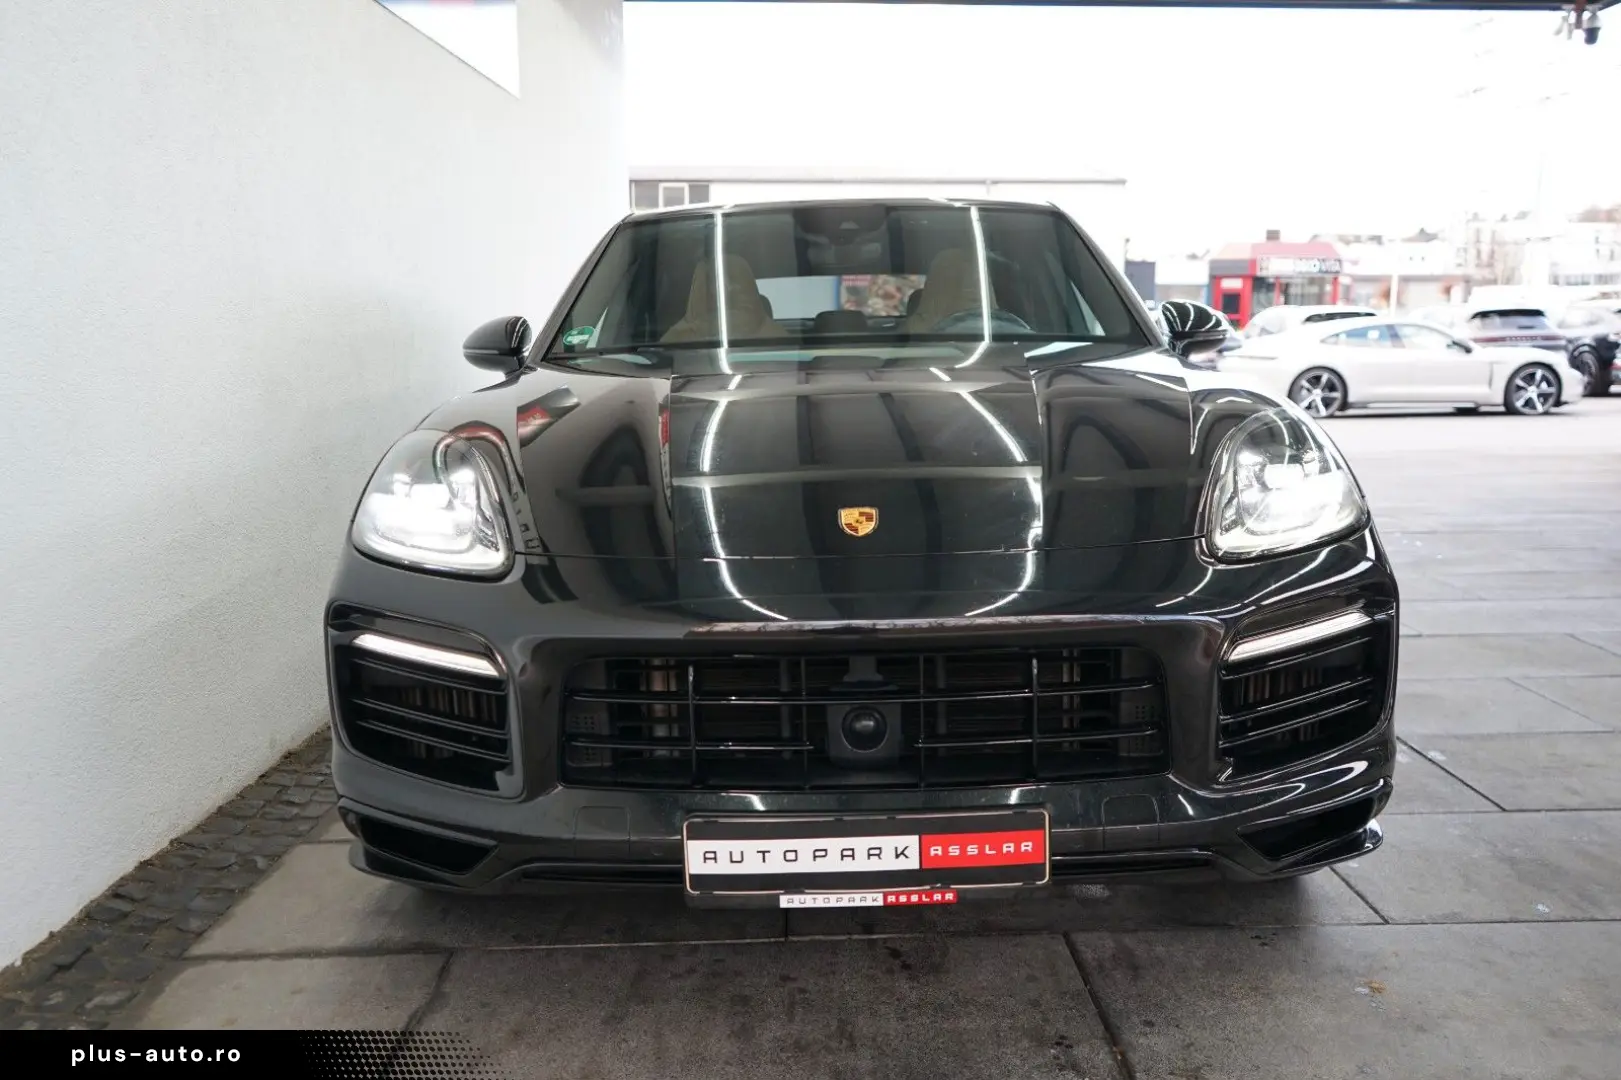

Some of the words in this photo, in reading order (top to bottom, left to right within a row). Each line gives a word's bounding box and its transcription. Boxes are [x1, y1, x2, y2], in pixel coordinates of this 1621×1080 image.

[702, 845, 910, 864] AUTOPARK
[929, 841, 1034, 857] ASSLAR
[786, 896, 880, 906] AUTOPARK
[886, 892, 954, 903] ASSLAR
